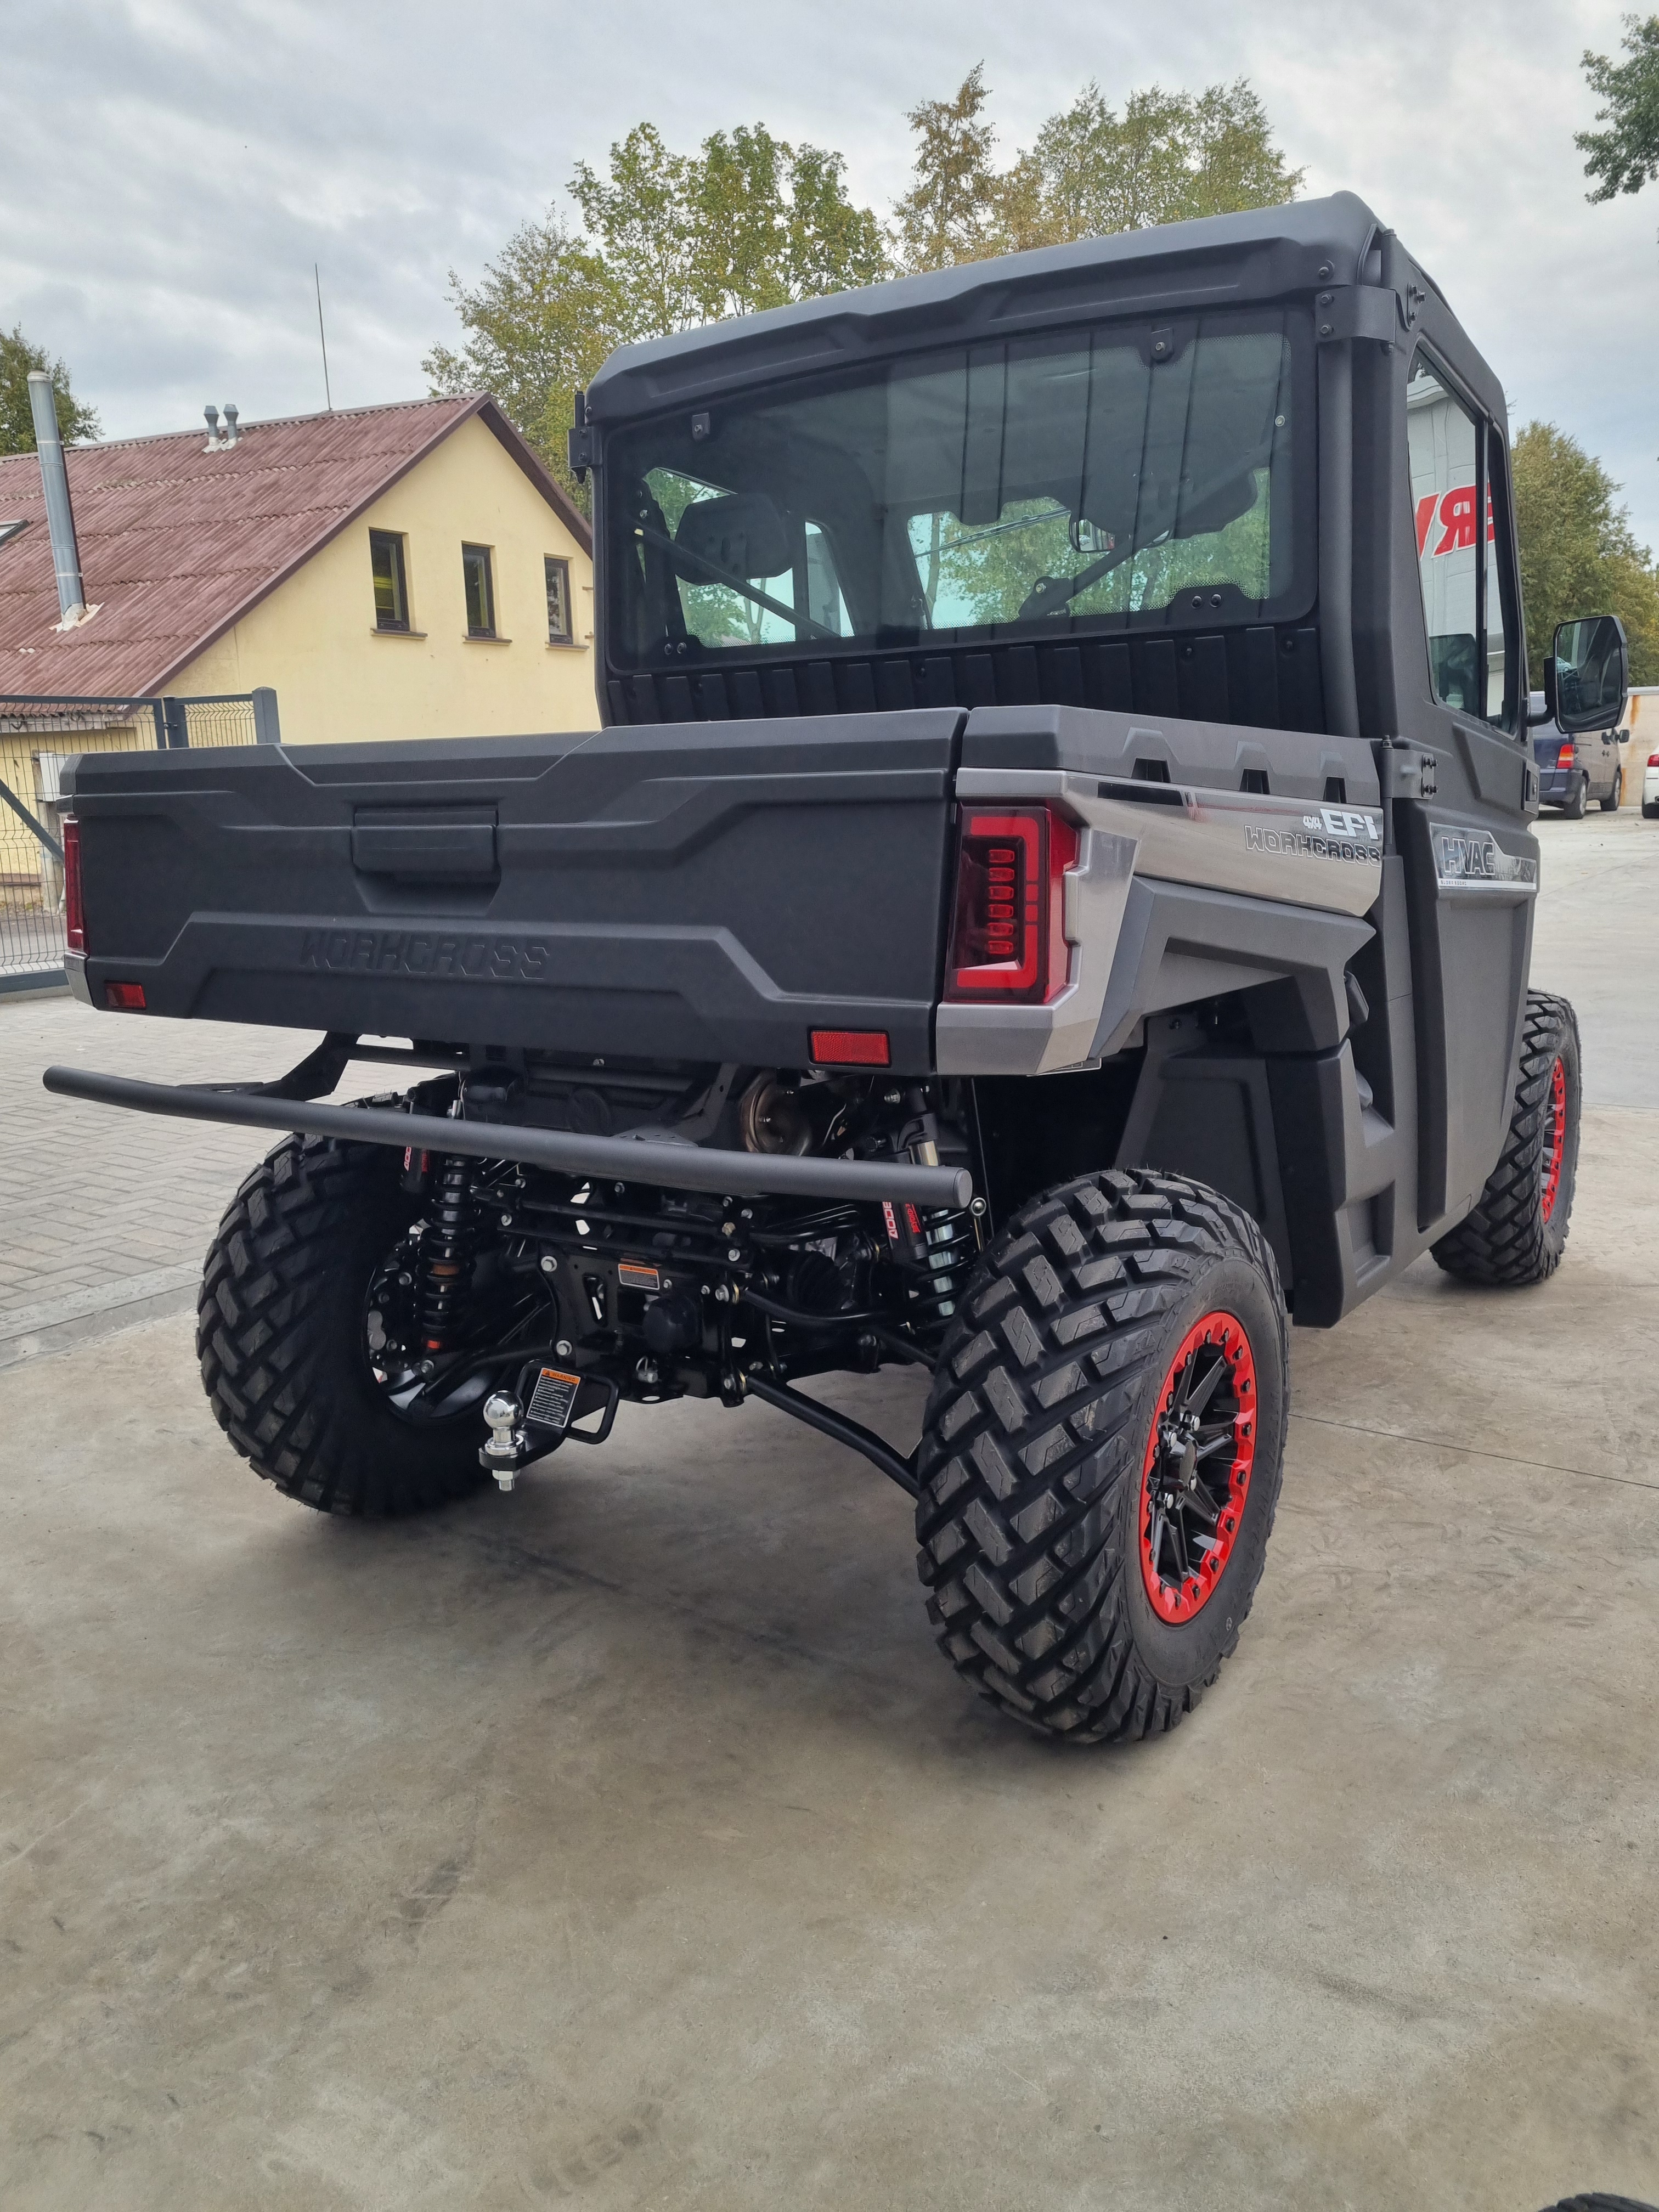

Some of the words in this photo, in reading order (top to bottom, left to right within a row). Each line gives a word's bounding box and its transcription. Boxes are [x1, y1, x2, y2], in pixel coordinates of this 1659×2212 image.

[1320, 808, 1379, 840] EFI
[1245, 825, 1381, 867] WORKCROSS
[1441, 837, 1495, 875] HVAC
[299, 933, 549, 980] WORKCROSS
[552, 1372, 575, 1382] WARNING
